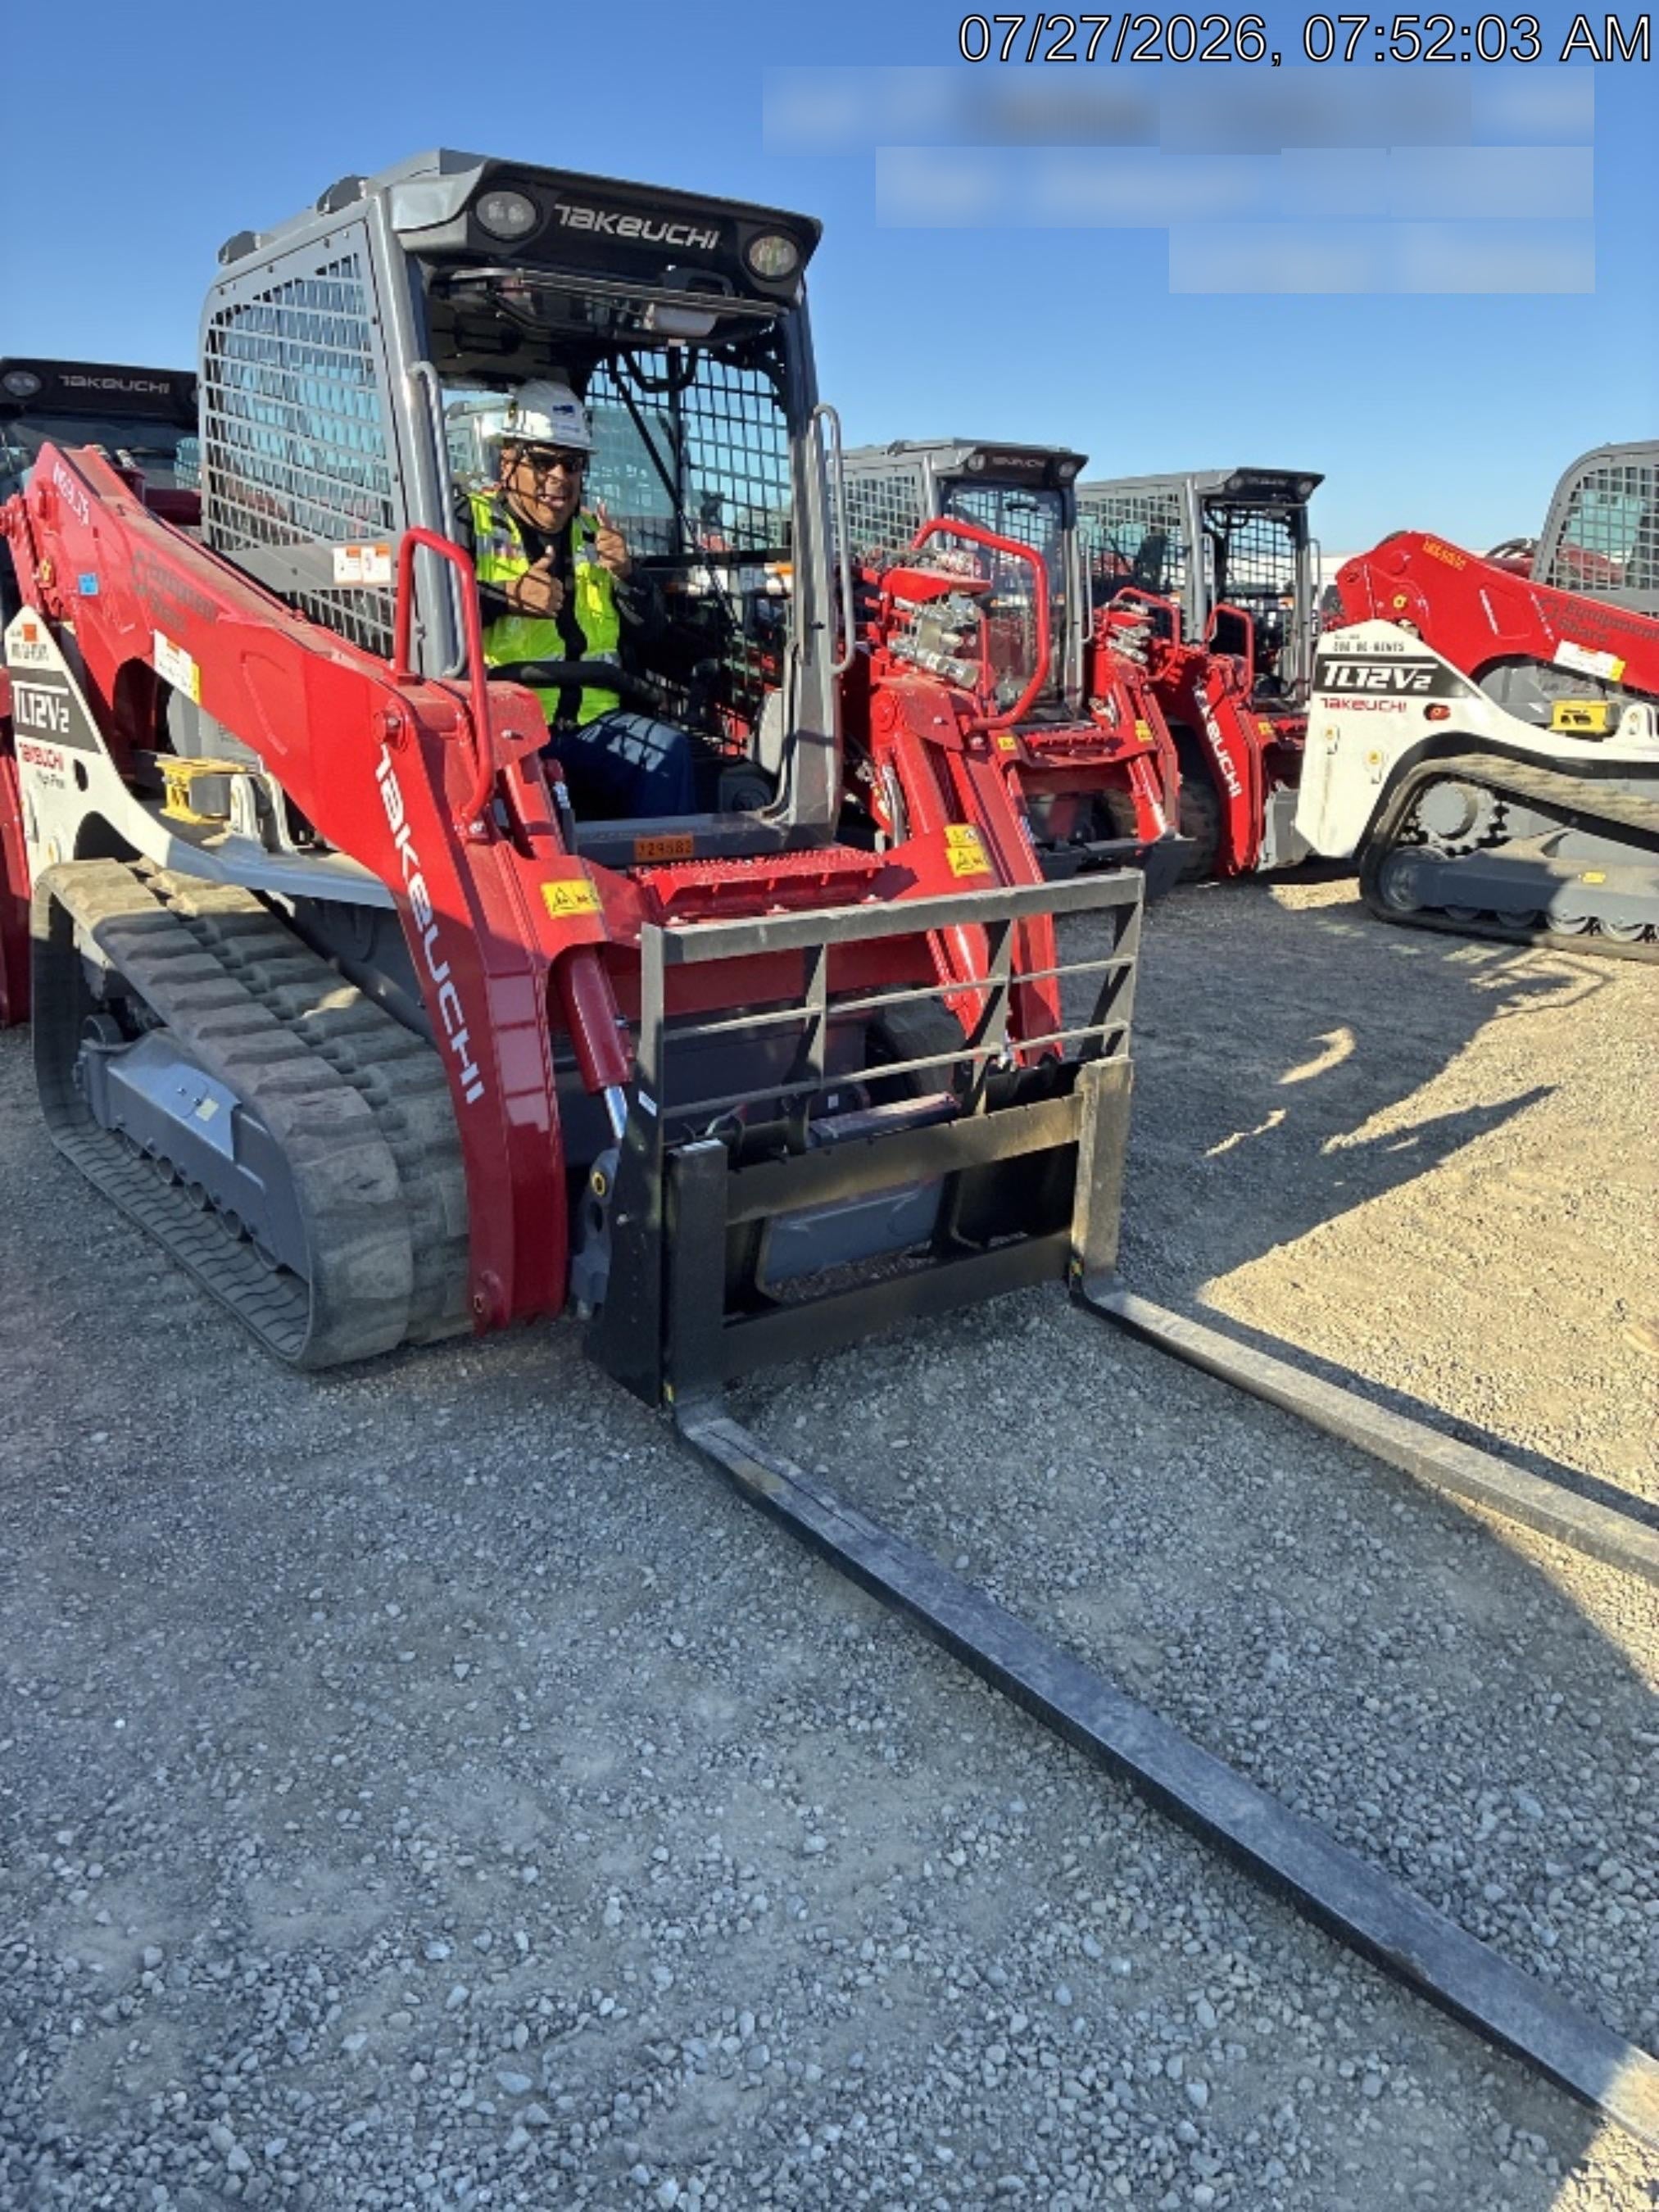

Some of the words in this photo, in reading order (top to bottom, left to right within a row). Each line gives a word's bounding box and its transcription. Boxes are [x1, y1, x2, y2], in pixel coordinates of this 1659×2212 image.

[554, 203, 720, 249] TAKEUCHI
[58, 374, 170, 394] TAKEUCHI
[1320, 697, 1407, 713] TAKEUCHI
[375, 742, 486, 1105] TAKEUCHI
